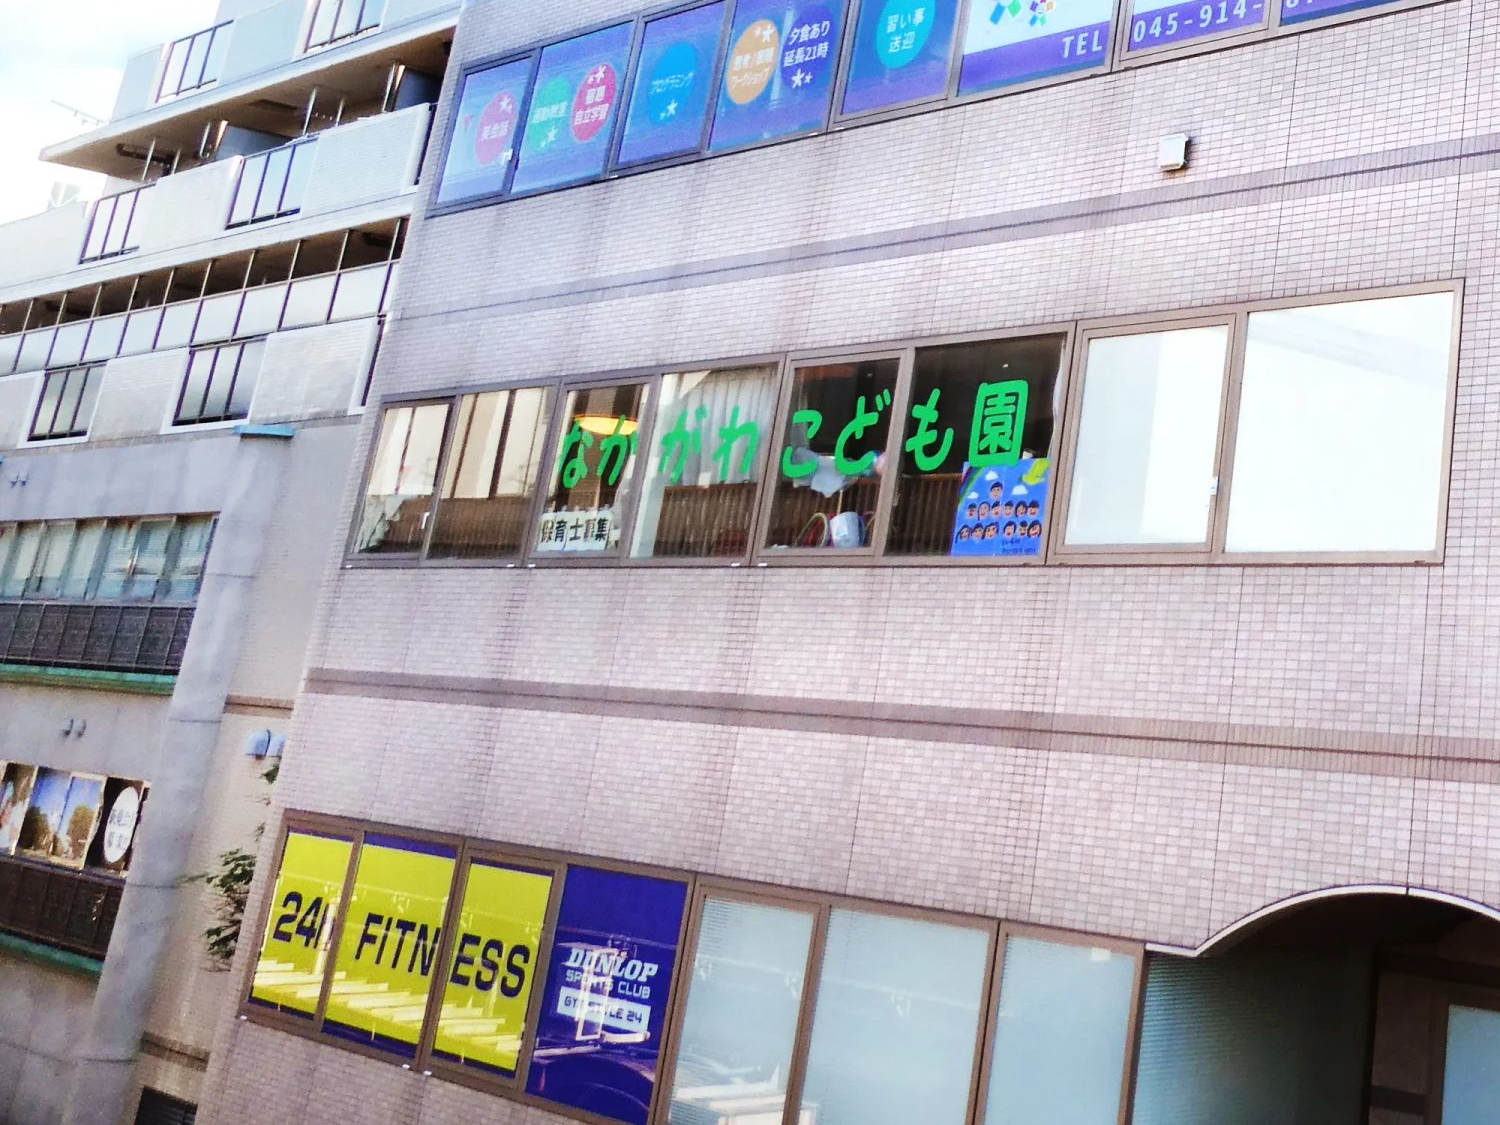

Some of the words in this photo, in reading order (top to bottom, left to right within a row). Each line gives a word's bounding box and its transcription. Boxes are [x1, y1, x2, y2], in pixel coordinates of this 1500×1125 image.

[789, 20, 831, 45] 夕食あり
[886, 7, 926, 34] 習い事
[783, 42, 830, 68] 延長21時
[1062, 34, 1103, 58] TEL
[354, 912, 531, 998] FITNESS
[561, 947, 659, 983] DUNLOP
[617, 981, 651, 999] CLUB
[626, 1010, 643, 1023] 24
